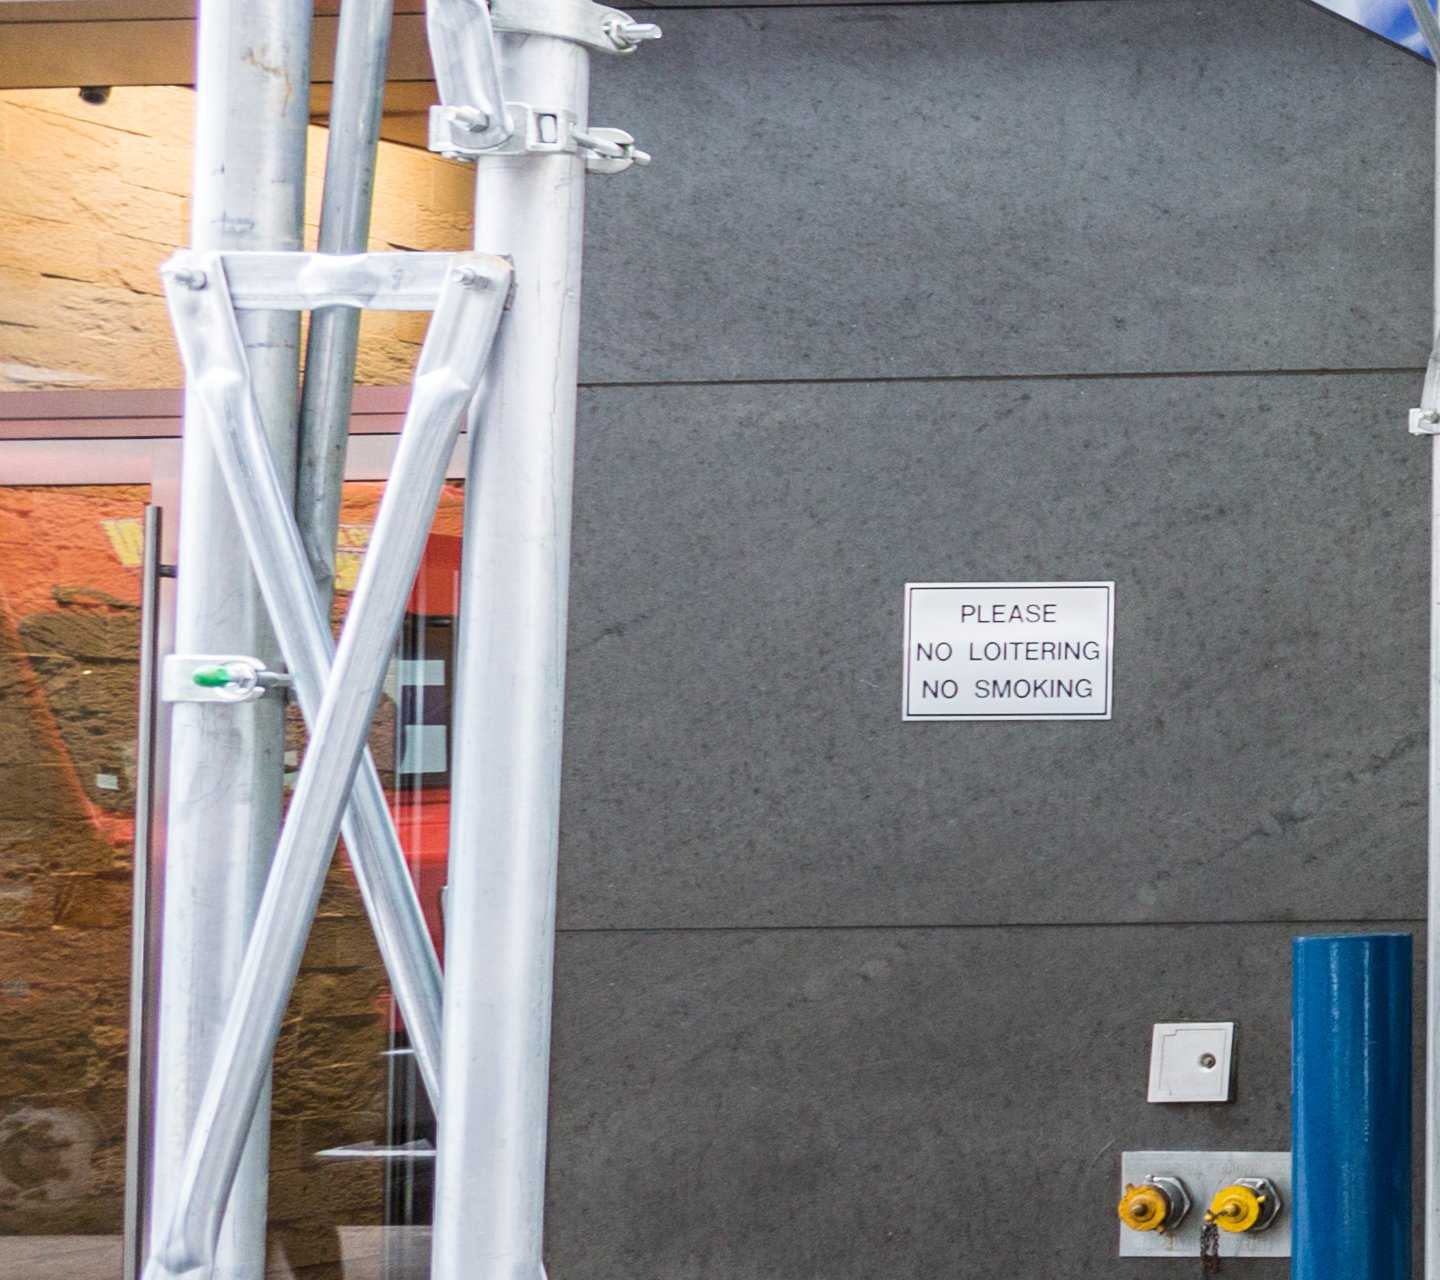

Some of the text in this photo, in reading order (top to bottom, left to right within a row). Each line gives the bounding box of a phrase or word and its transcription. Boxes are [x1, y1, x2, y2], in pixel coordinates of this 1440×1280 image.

[961, 604, 1057, 623] PLEASE
[917, 641, 1100, 661] NO LOITERING
[922, 678, 1092, 698] NO SMOKING
